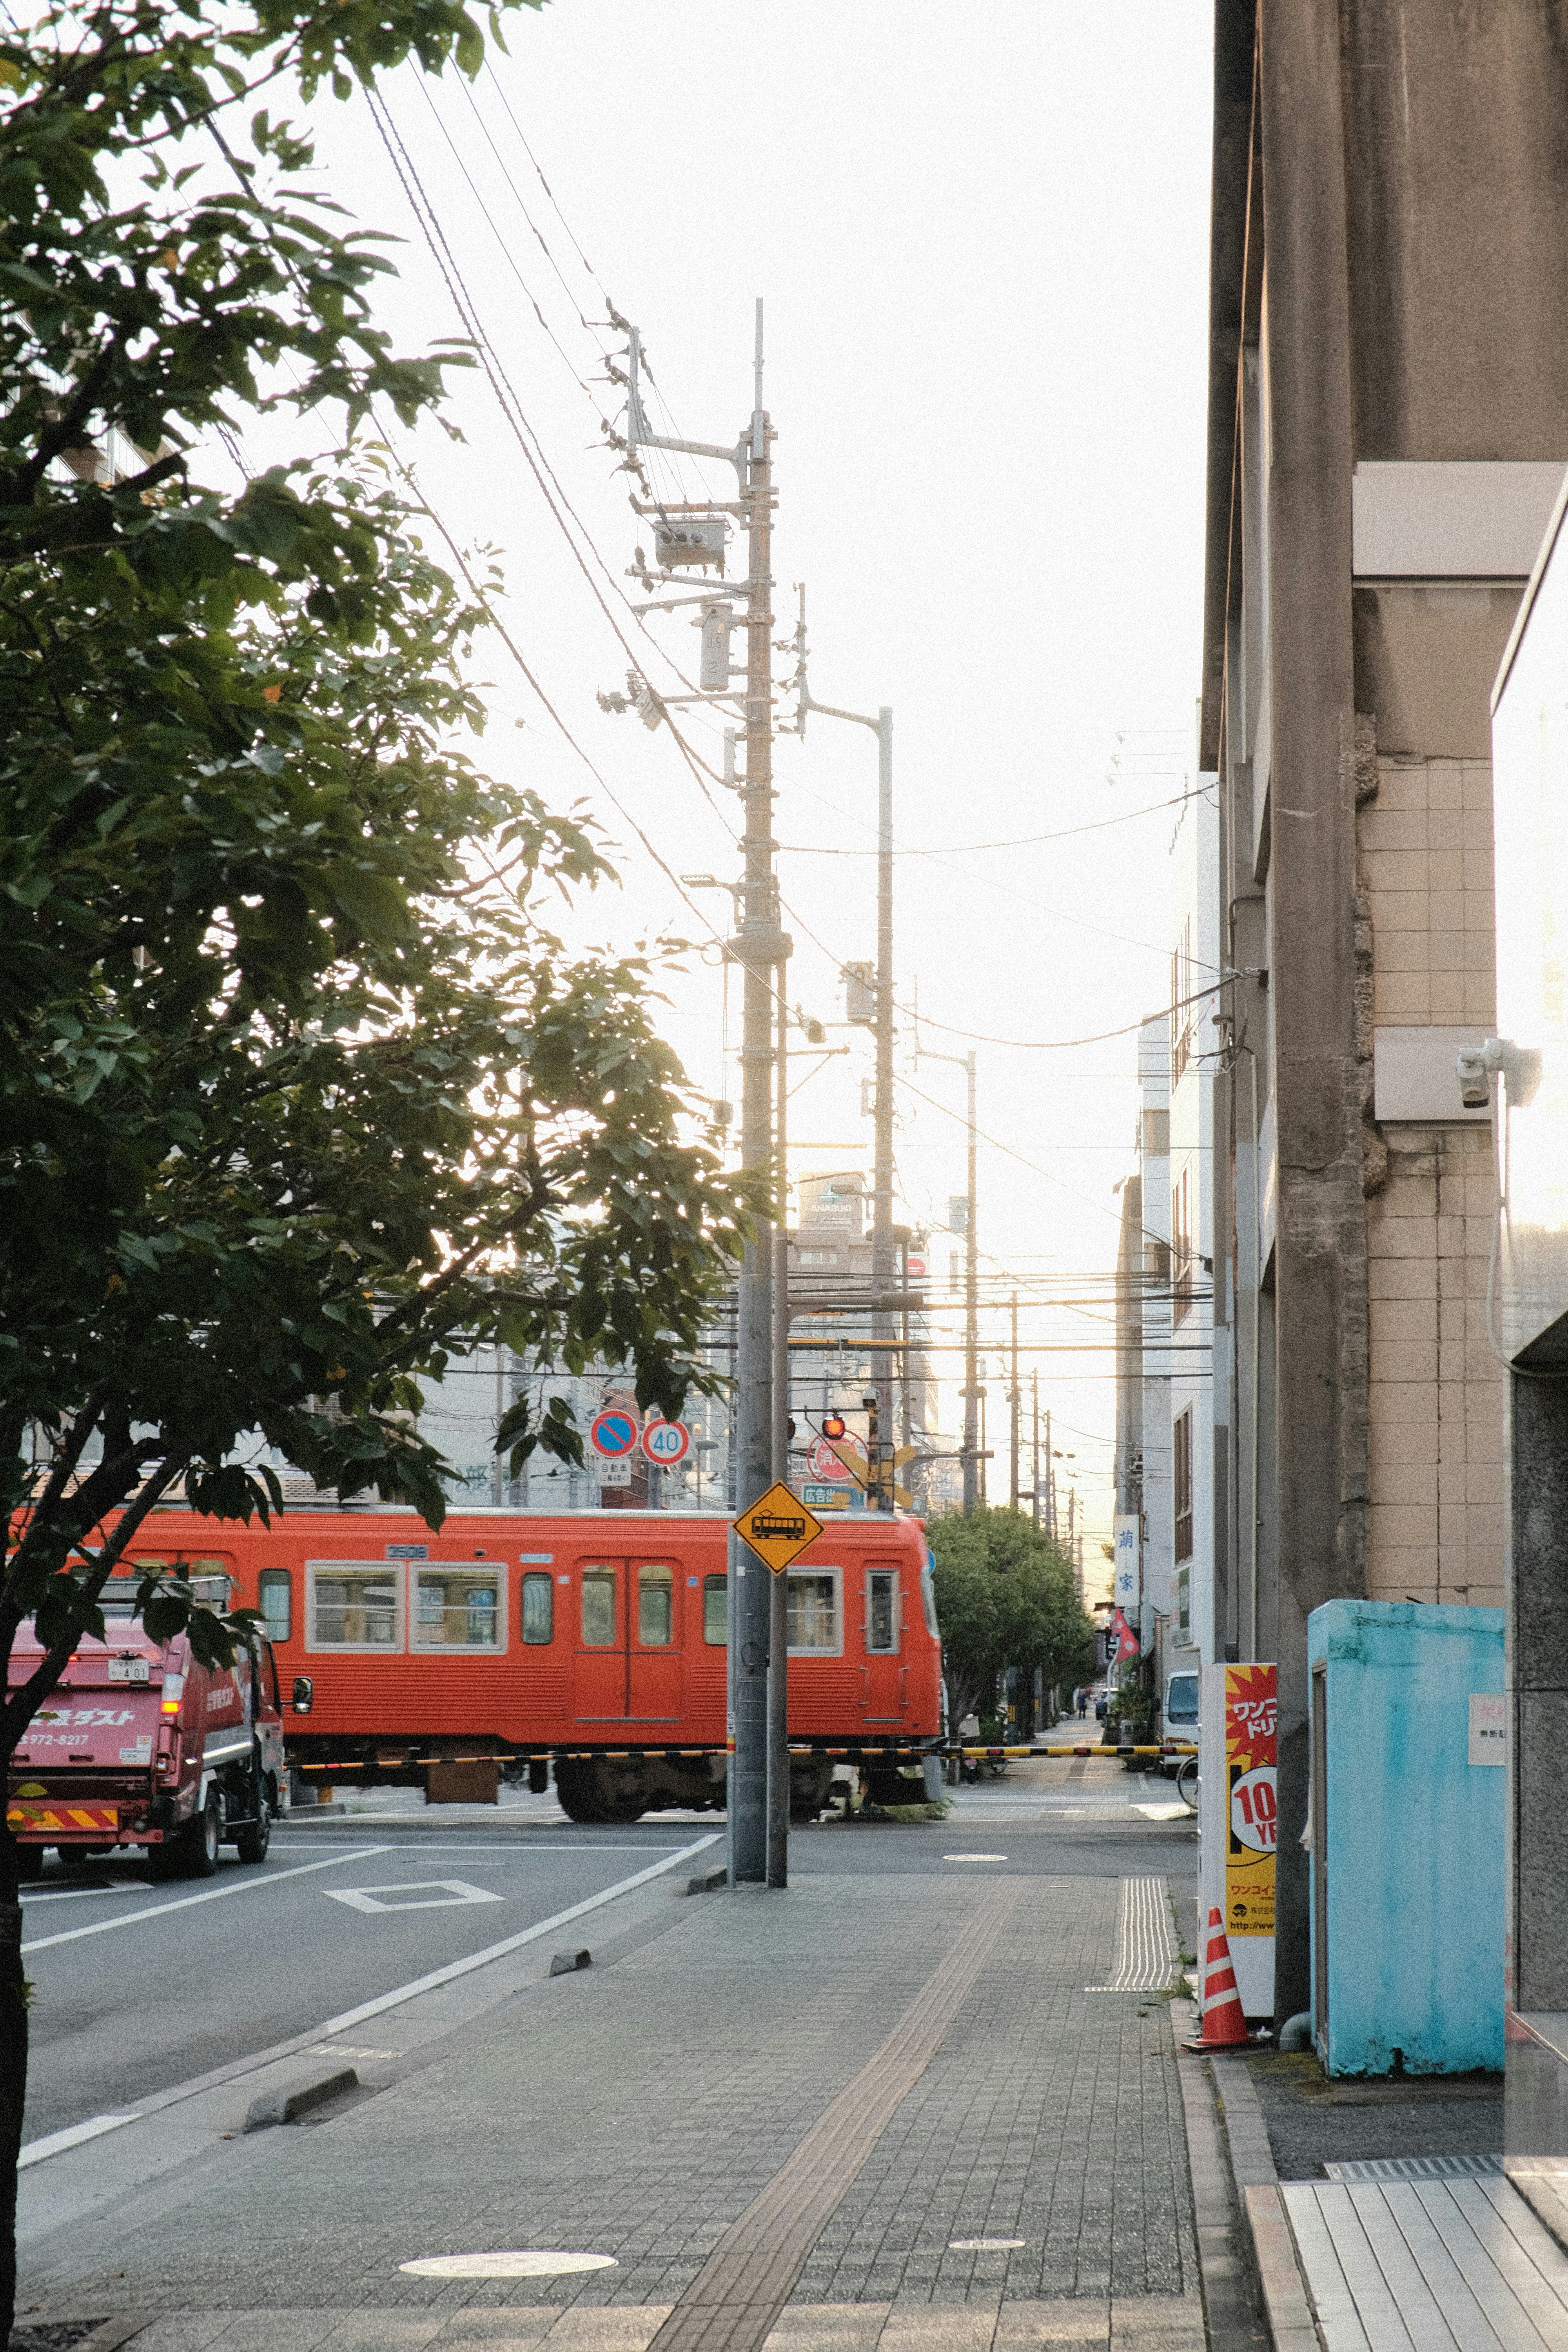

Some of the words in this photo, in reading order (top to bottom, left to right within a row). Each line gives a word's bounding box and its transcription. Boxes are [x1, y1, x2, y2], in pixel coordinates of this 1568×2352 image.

[653, 1431, 678, 1451] 40
[602, 1463, 626, 1472] 自動車
[1247, 1718, 1277, 1740] ドリ
[29, 1735, 89, 1745] 972-8217
